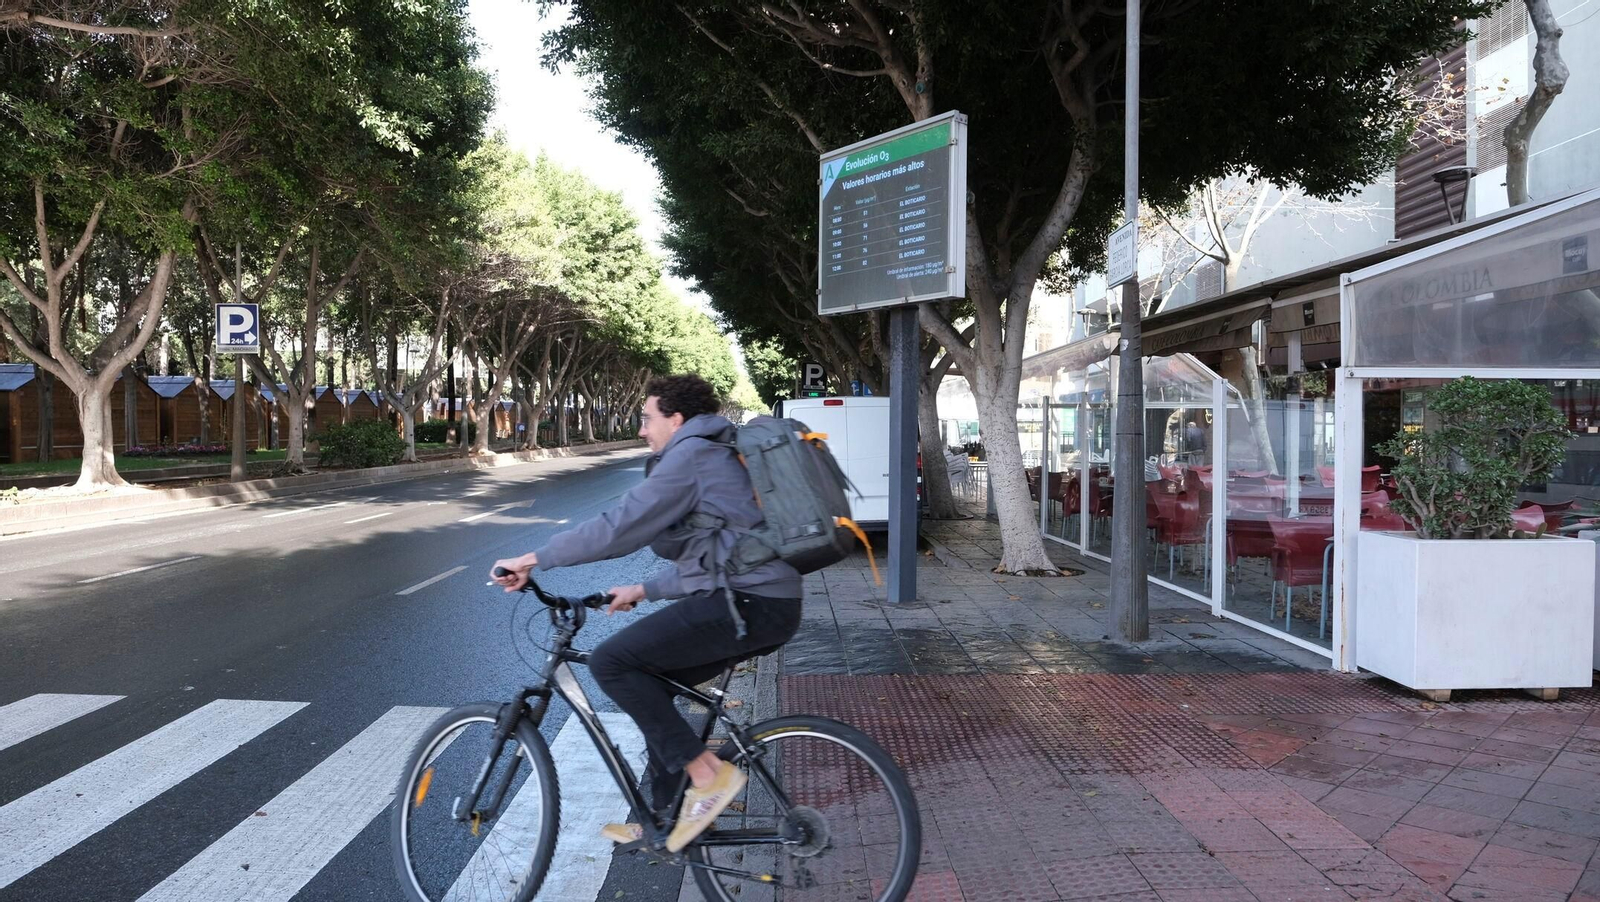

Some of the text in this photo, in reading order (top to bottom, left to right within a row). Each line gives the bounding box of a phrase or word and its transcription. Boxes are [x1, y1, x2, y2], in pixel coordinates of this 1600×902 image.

[845, 154, 878, 171] Evolución
[842, 159, 925, 191] Valores horarios más altos
[904, 195, 926, 206] BOTICARIO
[904, 208, 926, 219] BOTICARIO
[904, 222, 926, 232] BOTICARIO
[904, 235, 926, 245] BOTICARIO
[903, 248, 926, 258] BOTICARIO
[219, 306, 254, 344] P
[231, 337, 244, 345] 24h
[805, 363, 824, 385] P
